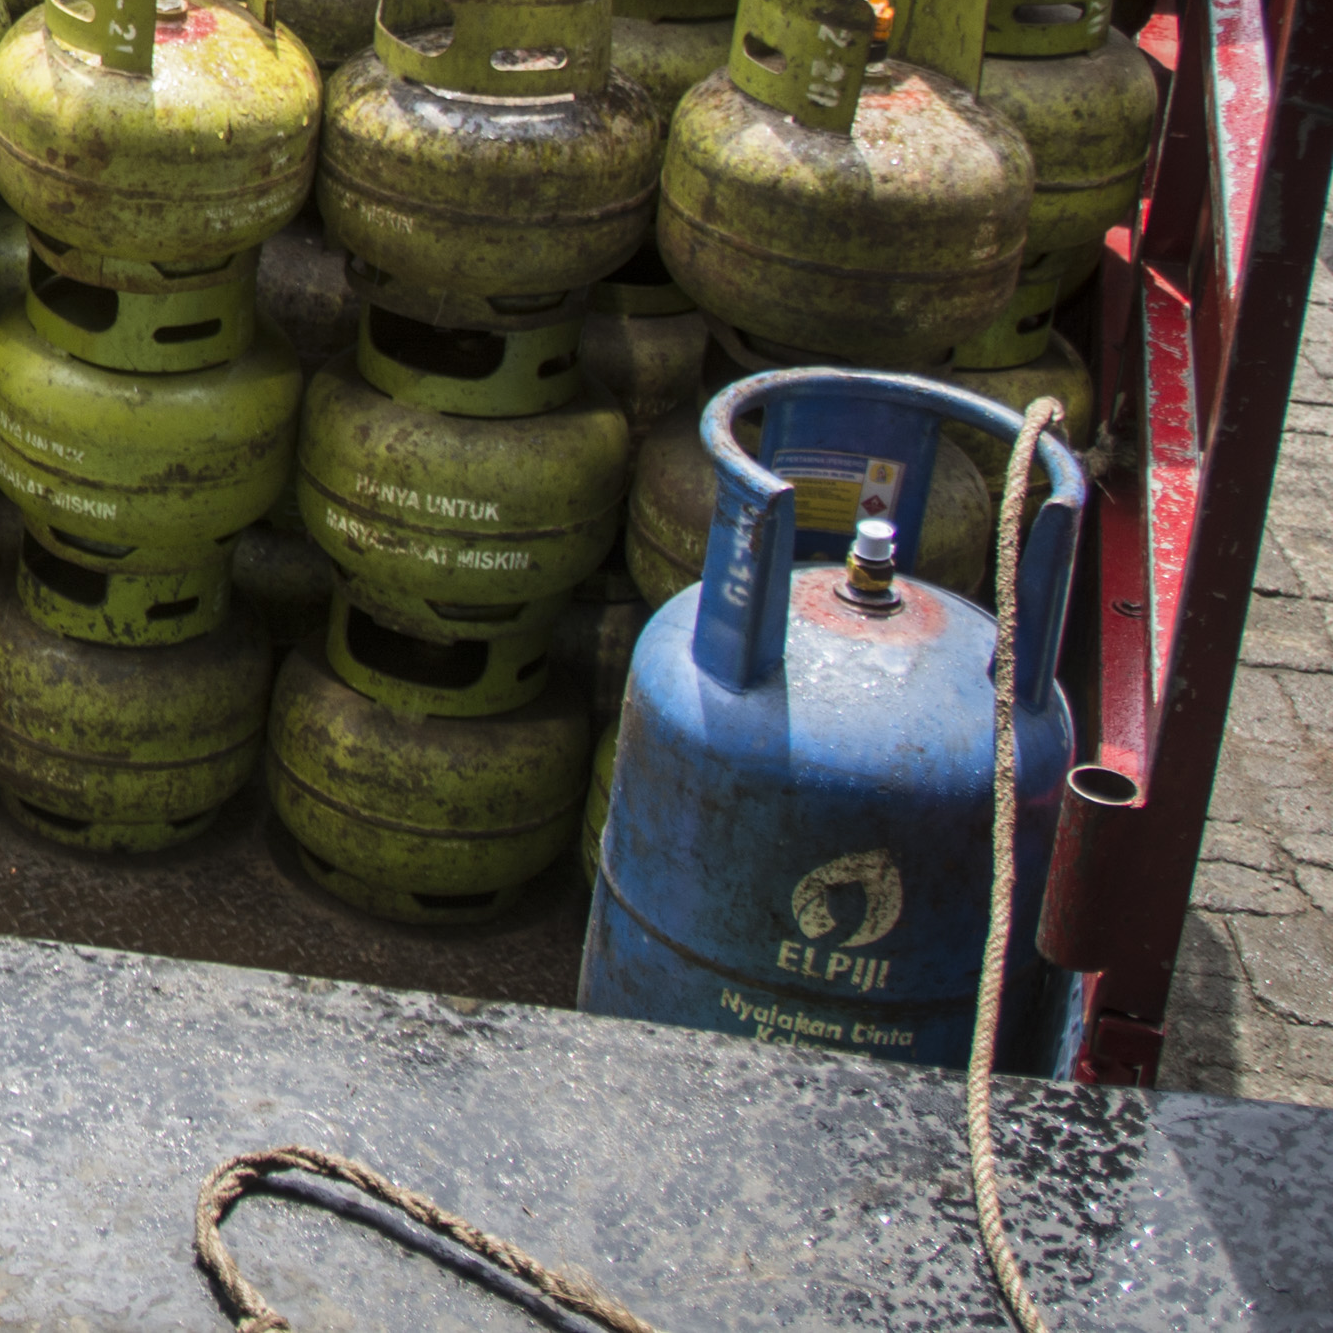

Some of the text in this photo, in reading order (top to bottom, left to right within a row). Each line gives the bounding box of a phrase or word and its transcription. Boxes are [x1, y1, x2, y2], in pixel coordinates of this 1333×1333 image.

[356, 472, 501, 522] HANYA UNTUK
[456, 550, 531, 571] MISKIN
[776, 939, 891, 995] ELPIJI
[719, 986, 843, 1041] Nyalakan
[850, 1020, 916, 1047] Cinta
